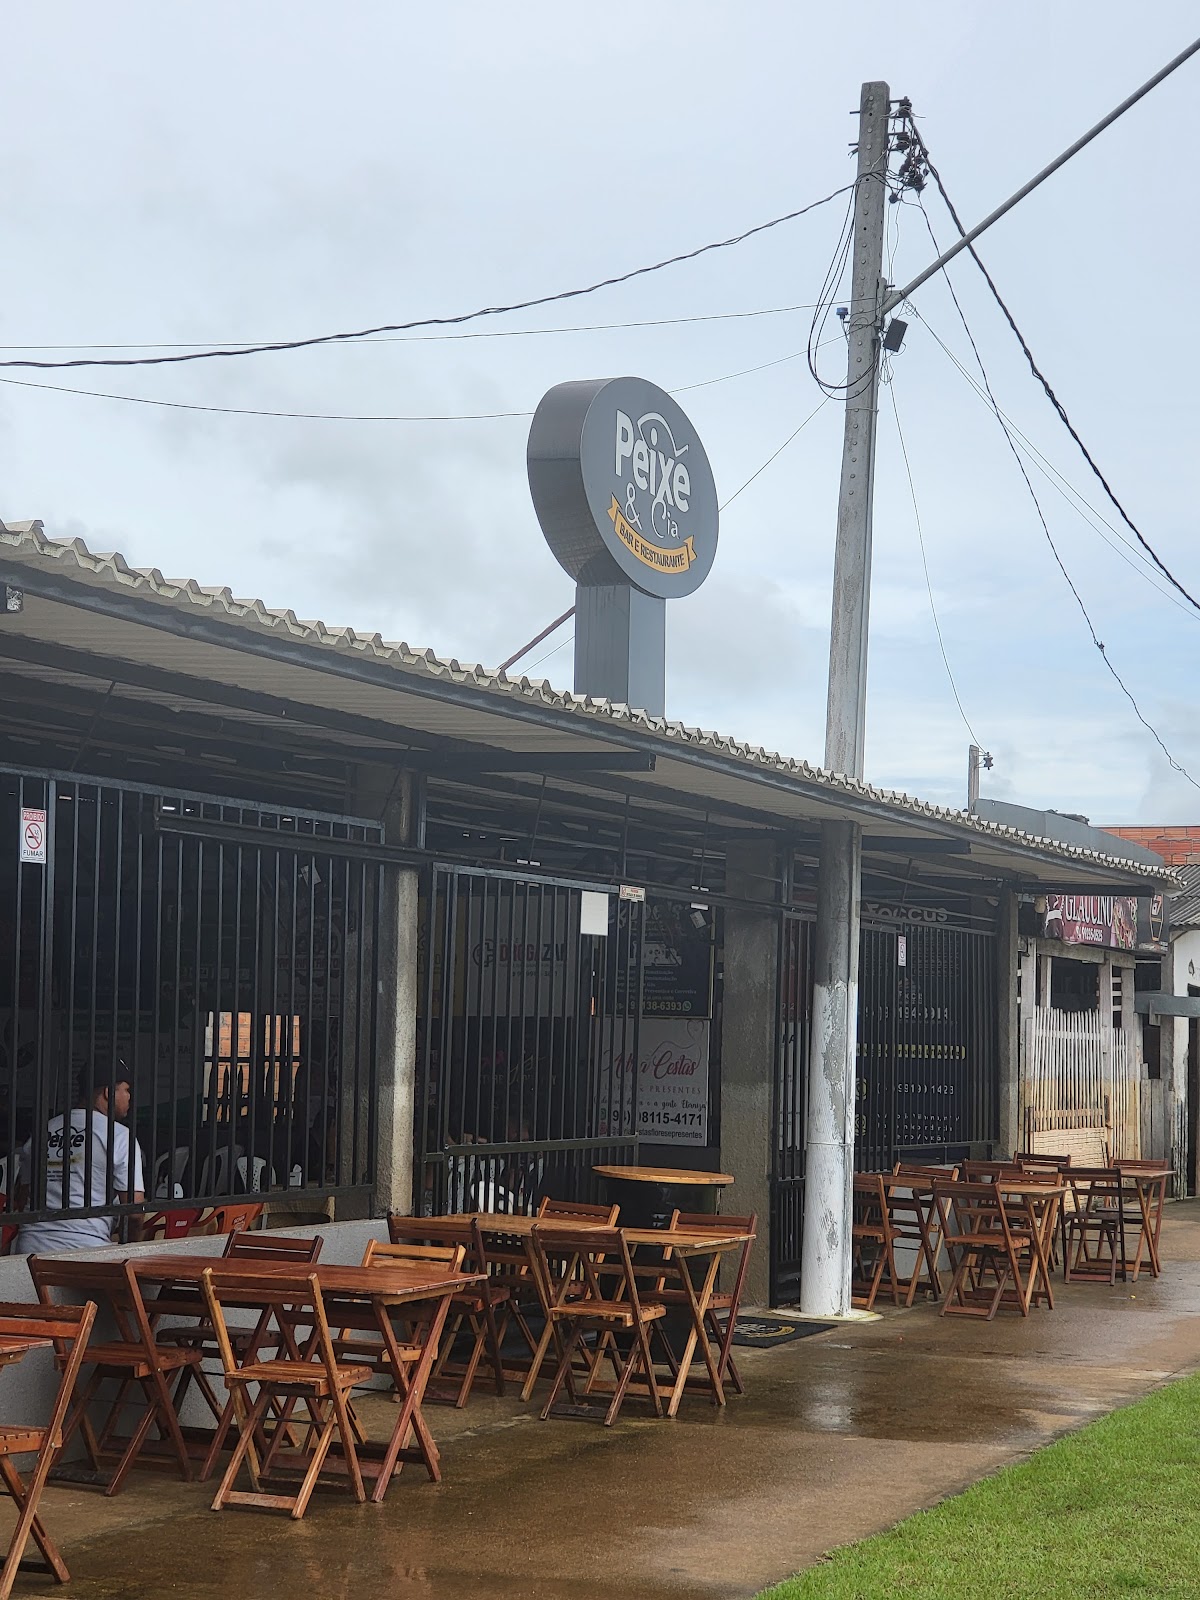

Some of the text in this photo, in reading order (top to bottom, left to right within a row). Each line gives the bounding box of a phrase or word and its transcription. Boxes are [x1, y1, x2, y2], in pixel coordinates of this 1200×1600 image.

[615, 409, 691, 513] Peixe
[625, 482, 680, 540] & Cia
[619, 521, 685, 568] BAR E RESTAURANTE
[23, 811, 45, 822] PROIBIDO
[22, 849, 44, 857] FUMAR
[1065, 894, 1114, 927] GLAUCINO
[652, 1050, 698, 1080] Cestas
[649, 1085, 701, 1095] PRESENTES
